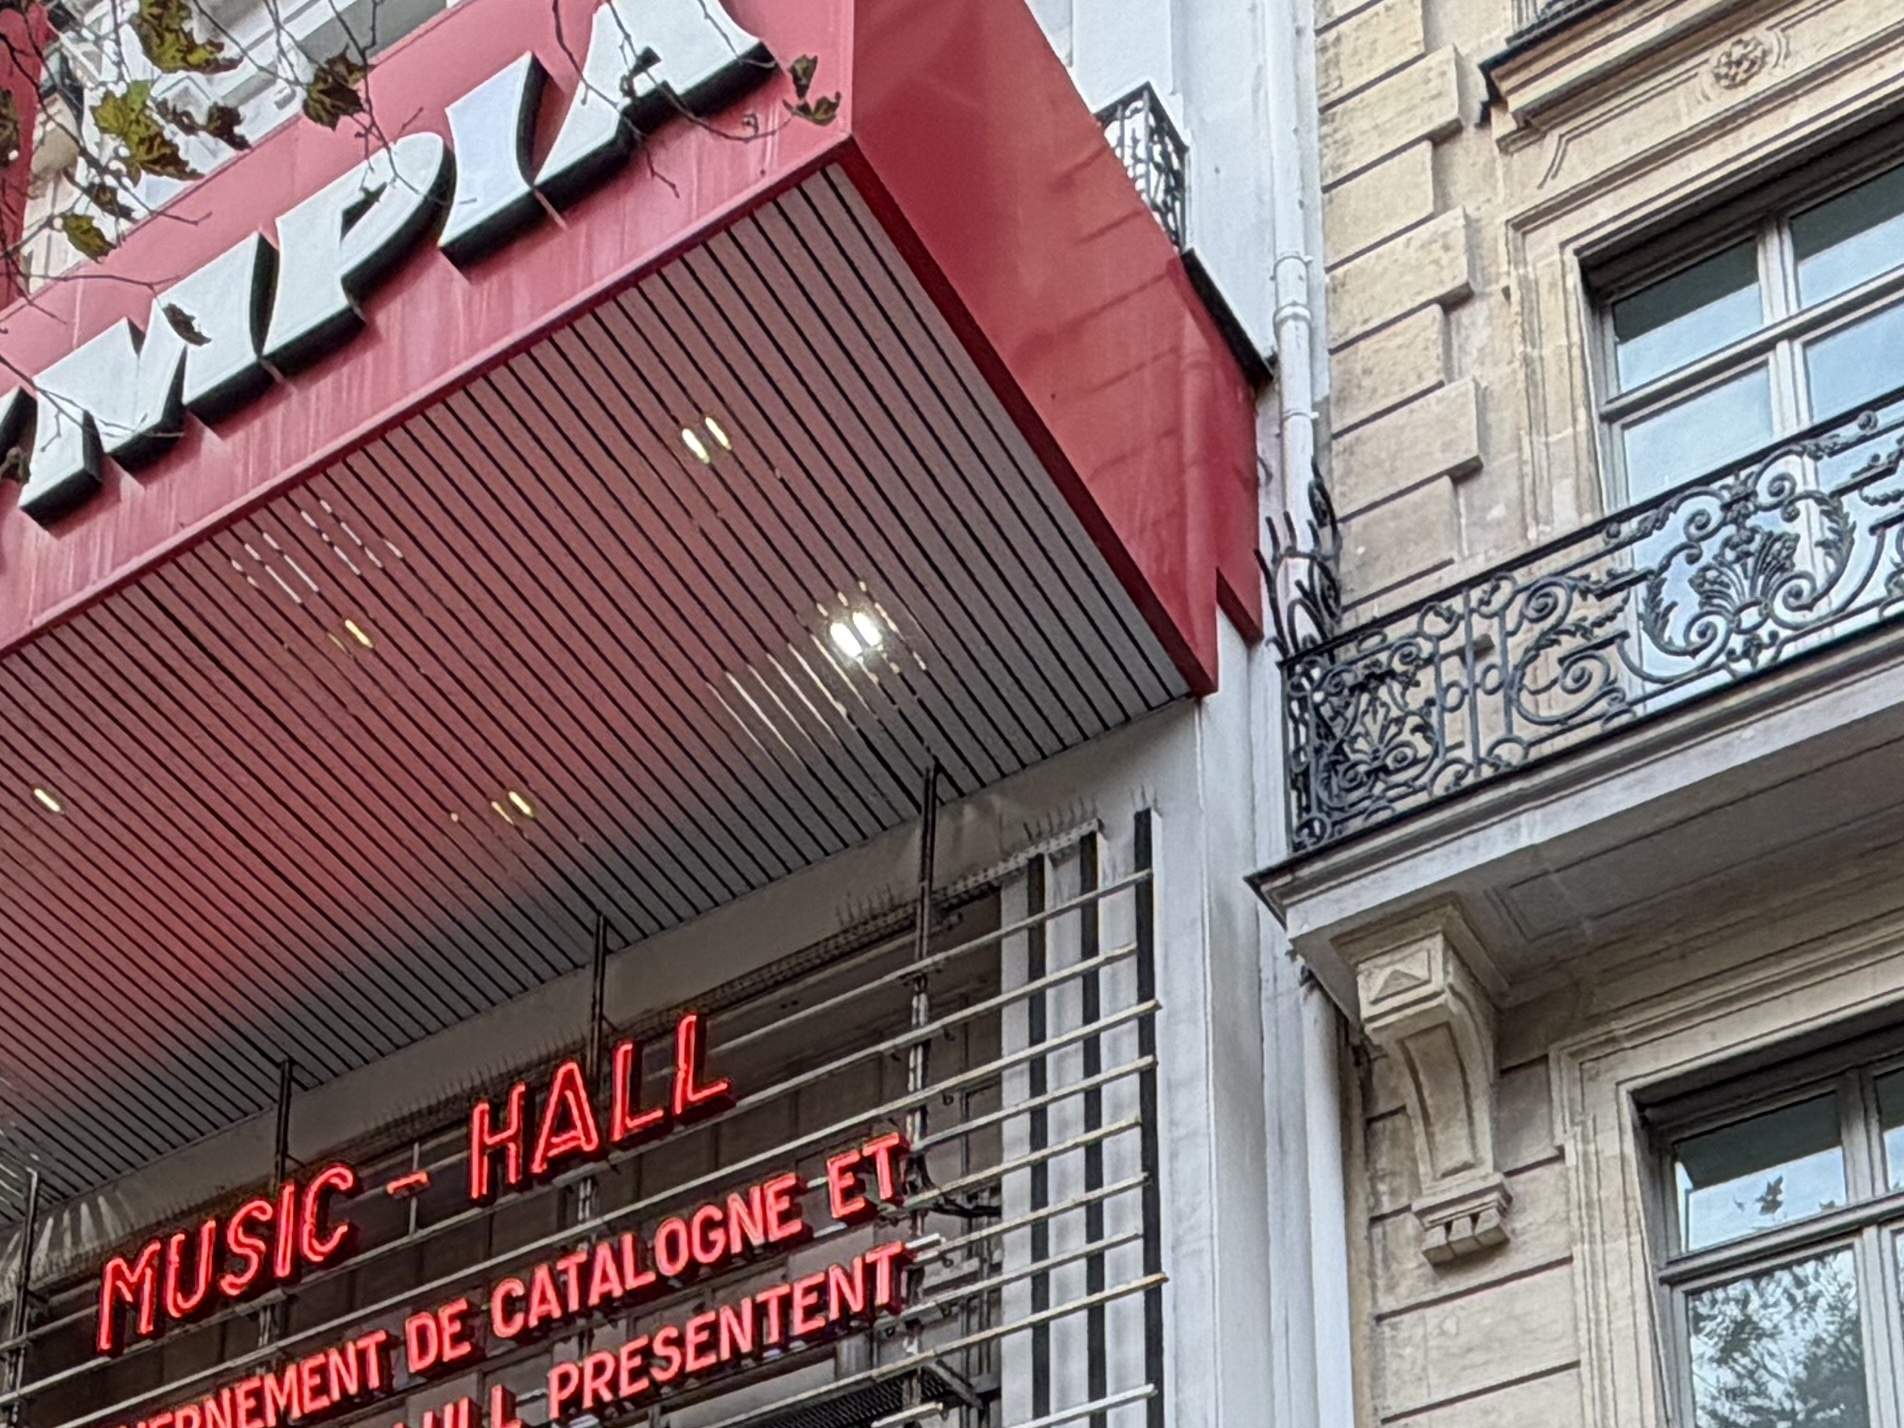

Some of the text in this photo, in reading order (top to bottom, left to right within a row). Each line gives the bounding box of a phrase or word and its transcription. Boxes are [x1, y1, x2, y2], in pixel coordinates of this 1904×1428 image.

[97, 1163, 358, 1355] MUSIC
[468, 1013, 732, 1202] HALL
[404, 1297, 474, 1375] DE
[491, 1172, 808, 1342] CATALOGNE
[827, 1133, 908, 1223] ET
[545, 1240, 908, 1422] PRESENTENT
